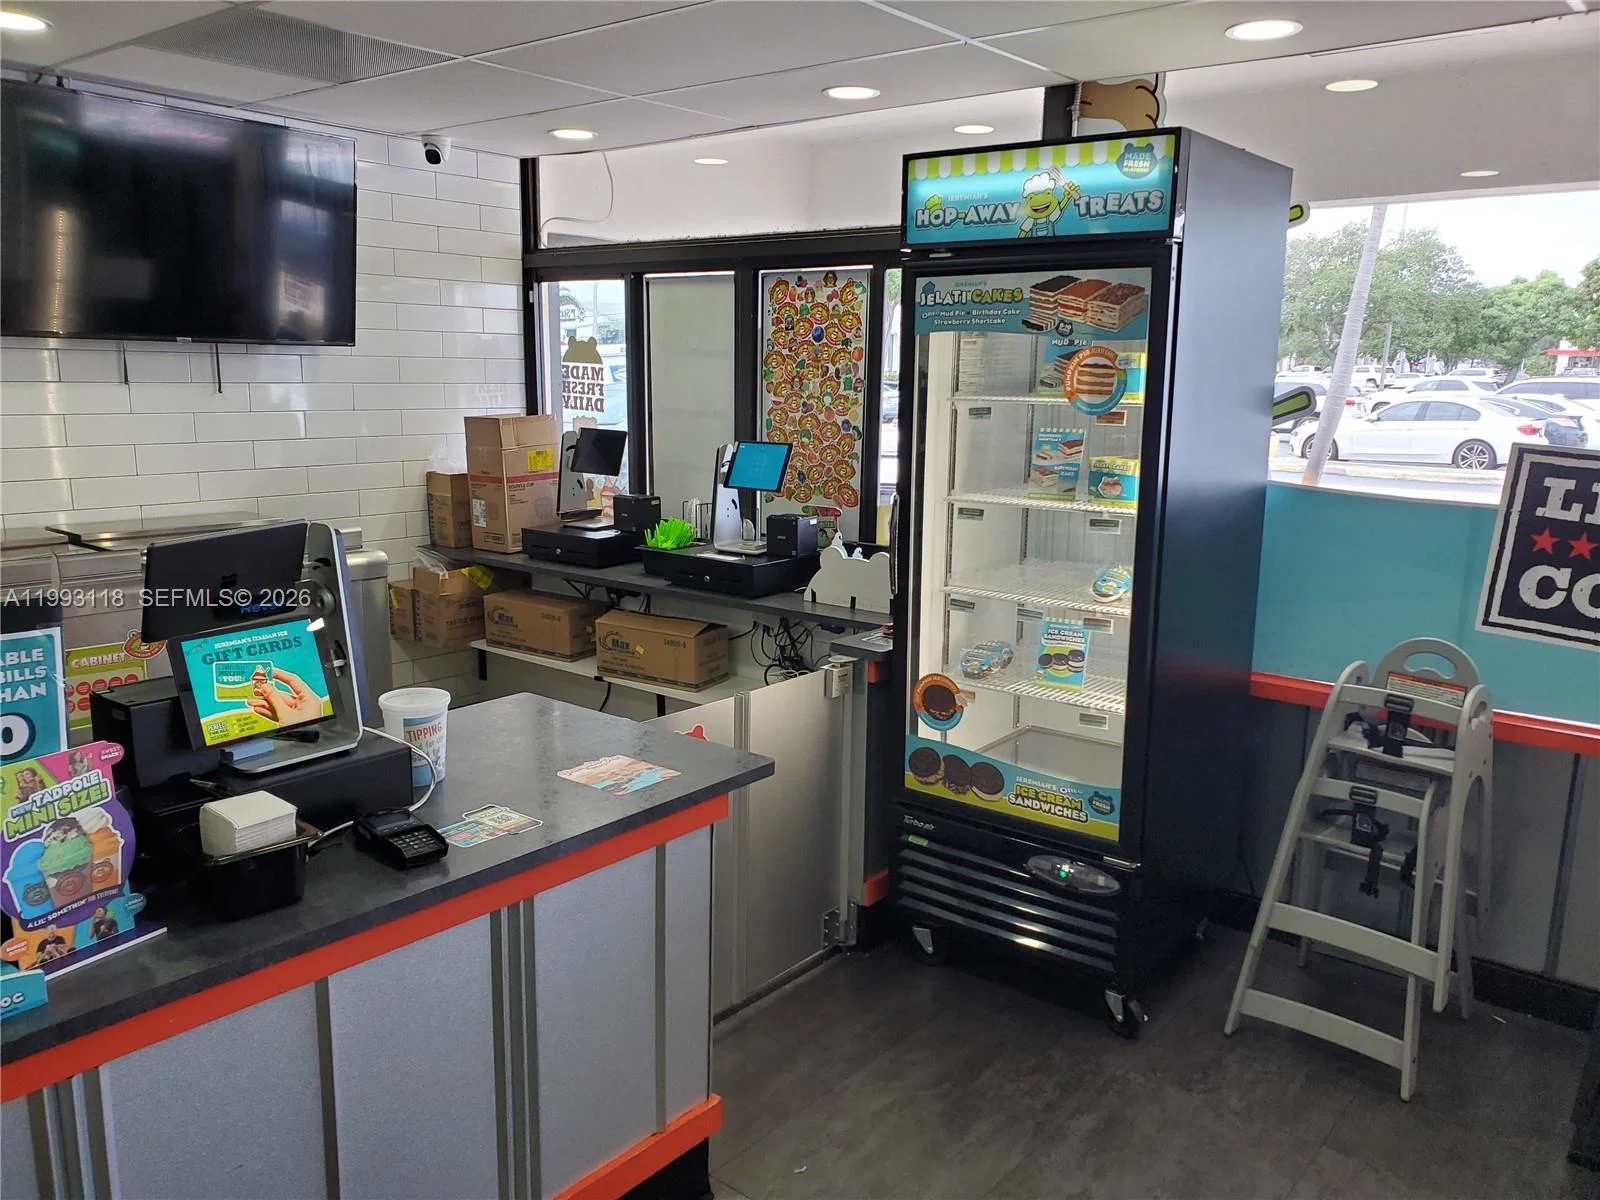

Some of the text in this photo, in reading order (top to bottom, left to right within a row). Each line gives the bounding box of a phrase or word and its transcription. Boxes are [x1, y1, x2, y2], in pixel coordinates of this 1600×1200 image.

[1123, 159, 1150, 168] FRESH
[1124, 151, 1151, 160] MADE
[916, 190, 1163, 228] HOP-AWAY TREATS
[971, 287, 1024, 304] CAKES
[972, 308, 1001, 317] Birthday
[1002, 308, 1020, 316] Cake
[934, 318, 970, 326] Strawberry
[1052, 338, 1070, 346] MUD
[201, 636, 303, 666] GIFT CARDS
[71, 652, 126, 669] CABINET
[406, 722, 442, 742] TIPPING
[11, 771, 101, 819] NEW TADPOLE
[1015, 785, 1083, 809] ICE CREAM
[5, 782, 109, 839] MINI SIZE!
[1008, 794, 1088, 822] SANDWICHES
